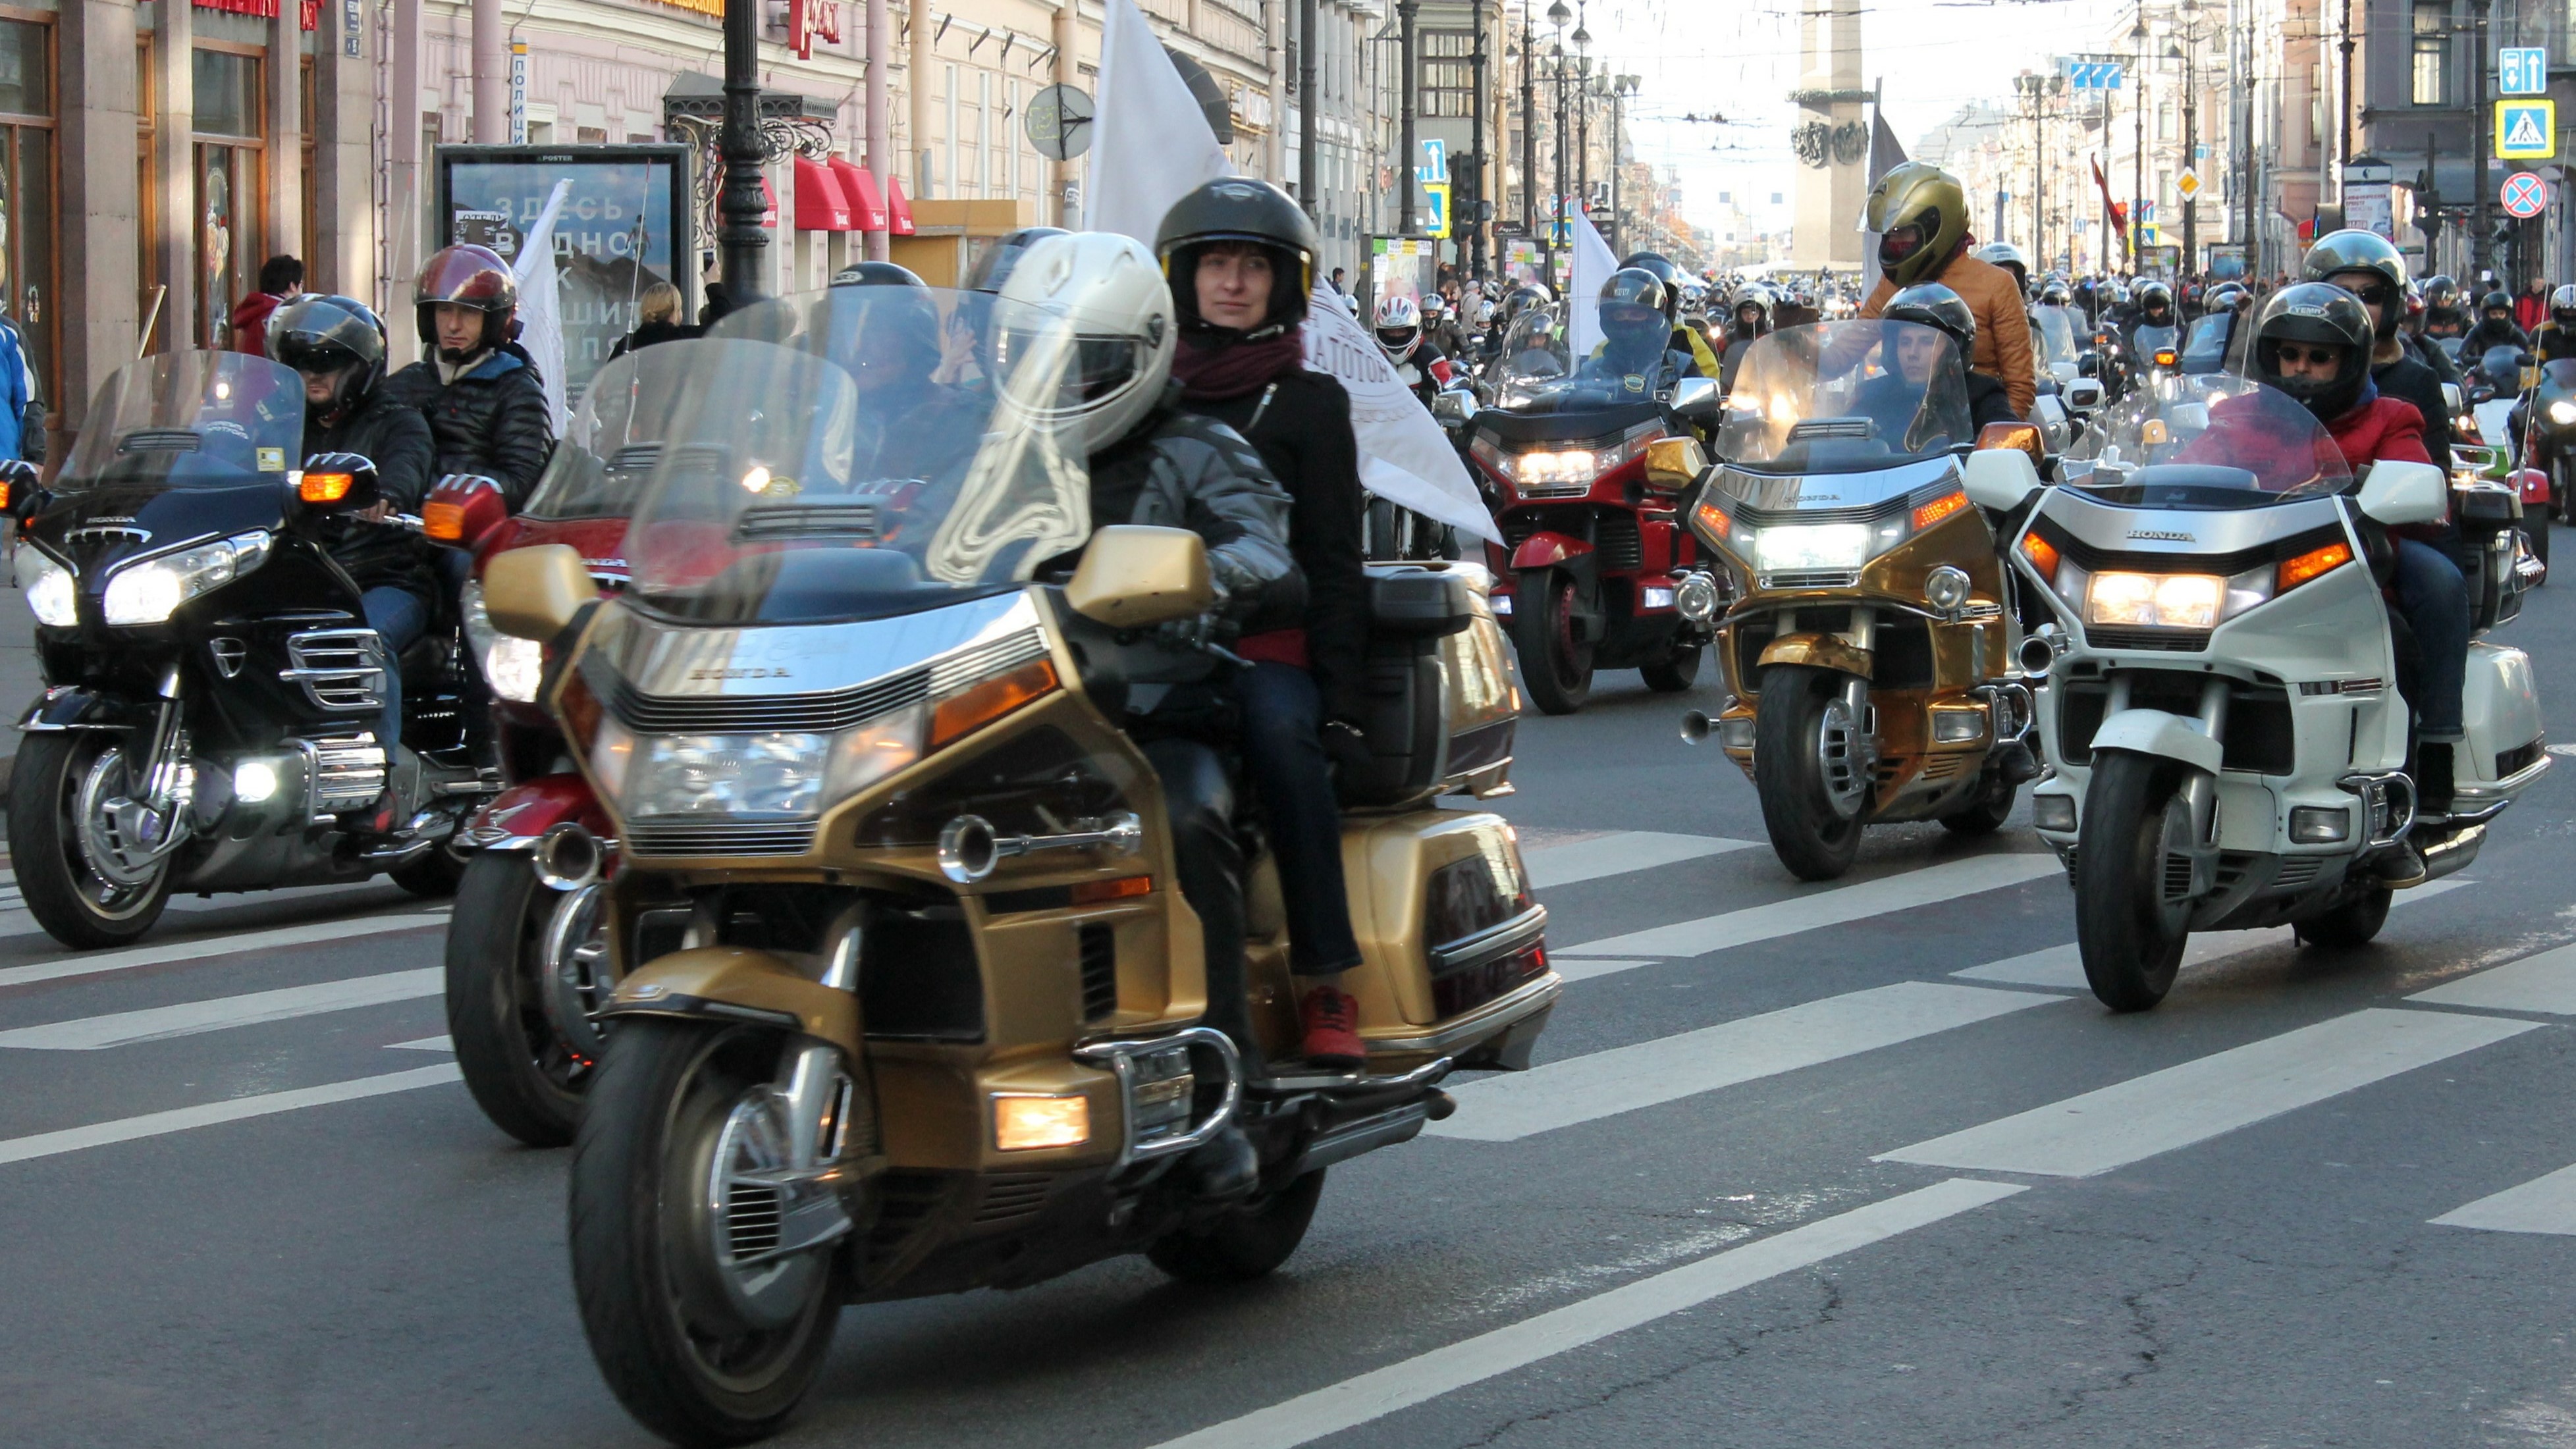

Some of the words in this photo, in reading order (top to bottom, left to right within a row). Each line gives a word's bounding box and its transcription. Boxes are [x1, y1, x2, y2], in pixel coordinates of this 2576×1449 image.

[514, 61, 523, 144] ПОЛИЦИ
[495, 232, 635, 260] ВДНО,
[2126, 531, 2196, 542] HONDA
[689, 668, 793, 679] HONDA
